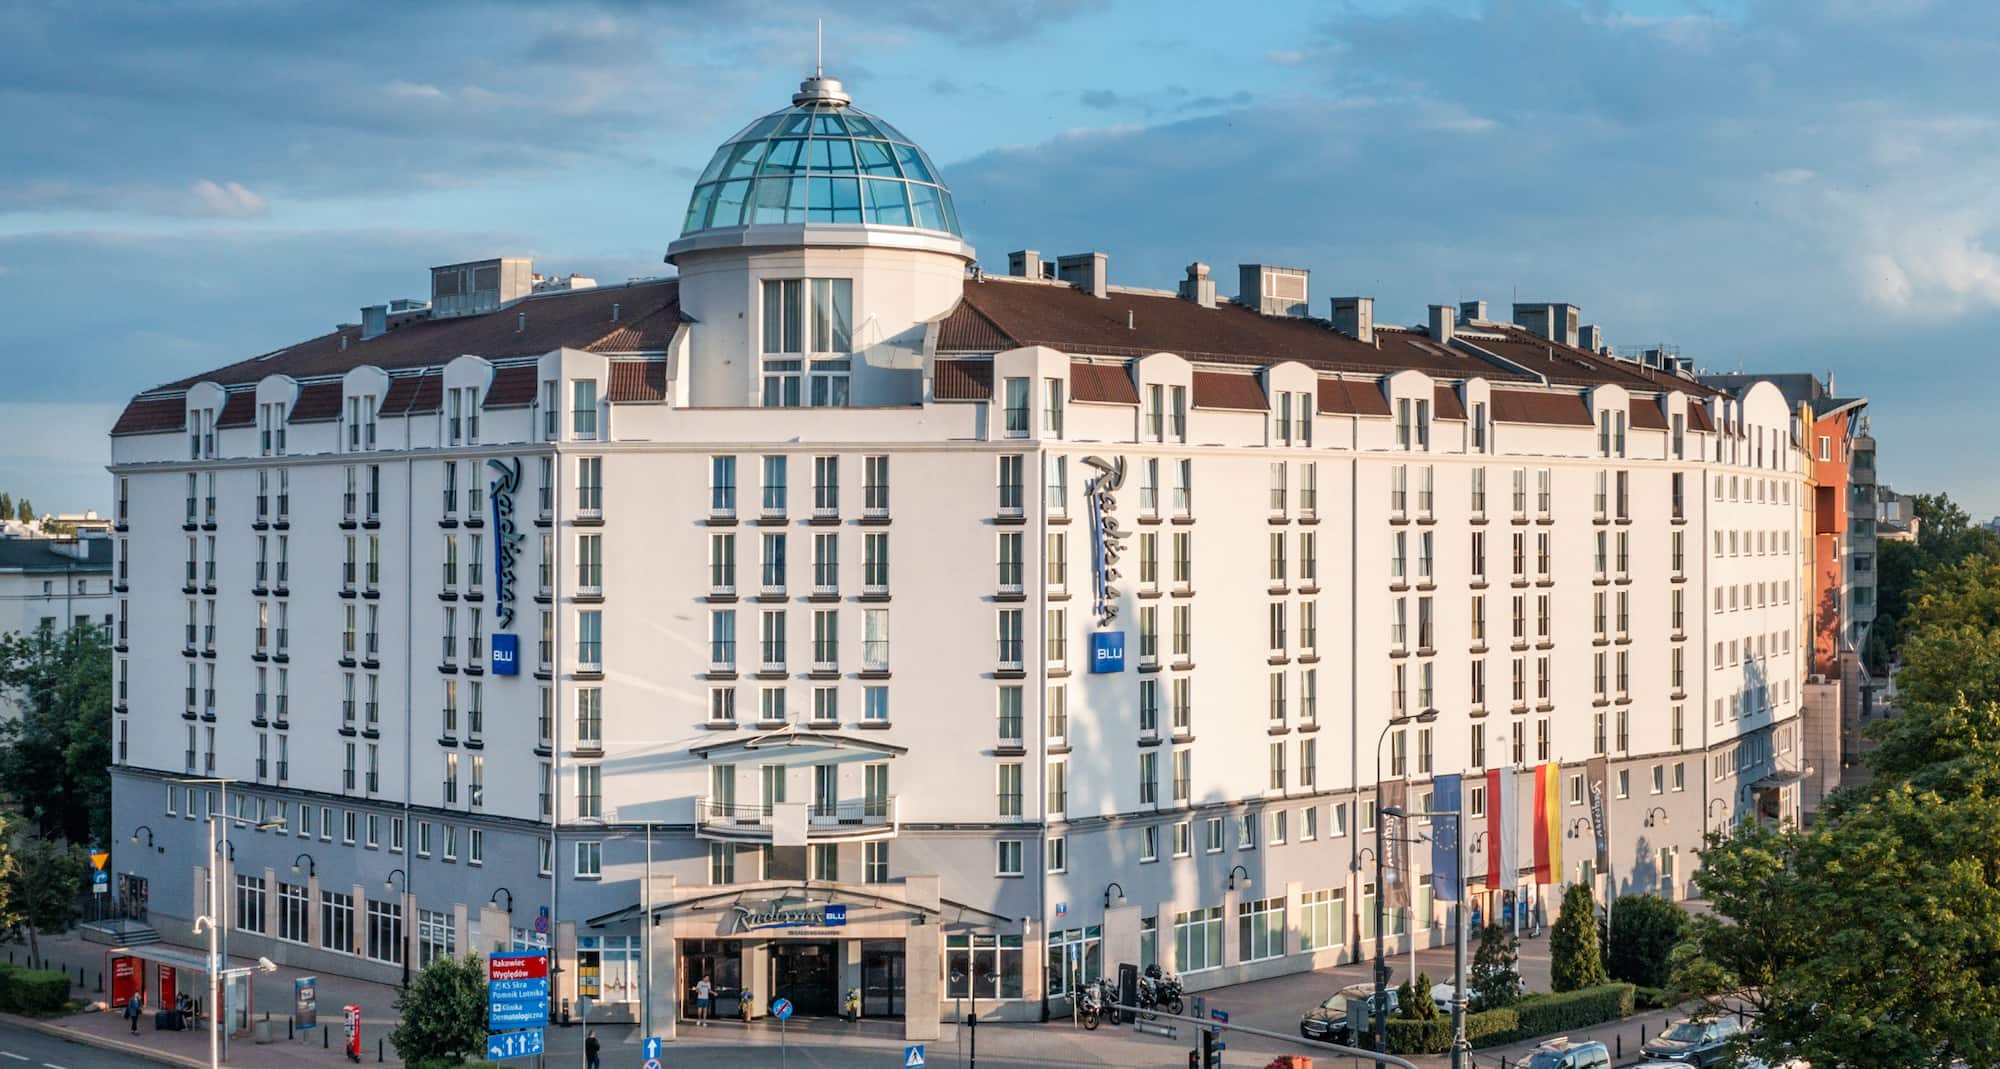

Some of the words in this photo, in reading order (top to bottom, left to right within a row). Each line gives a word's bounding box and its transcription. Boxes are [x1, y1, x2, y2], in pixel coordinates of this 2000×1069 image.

[486, 456, 526, 629] Radisson
[1084, 455, 1133, 627] Radisson
[493, 650, 513, 662] BLU
[1097, 647, 1122, 659] BLU
[732, 903, 823, 935] Radisson
[825, 912, 846, 920] BLU
[493, 959, 526, 968] Rakowiec
[493, 990, 518, 999] Pomnik
